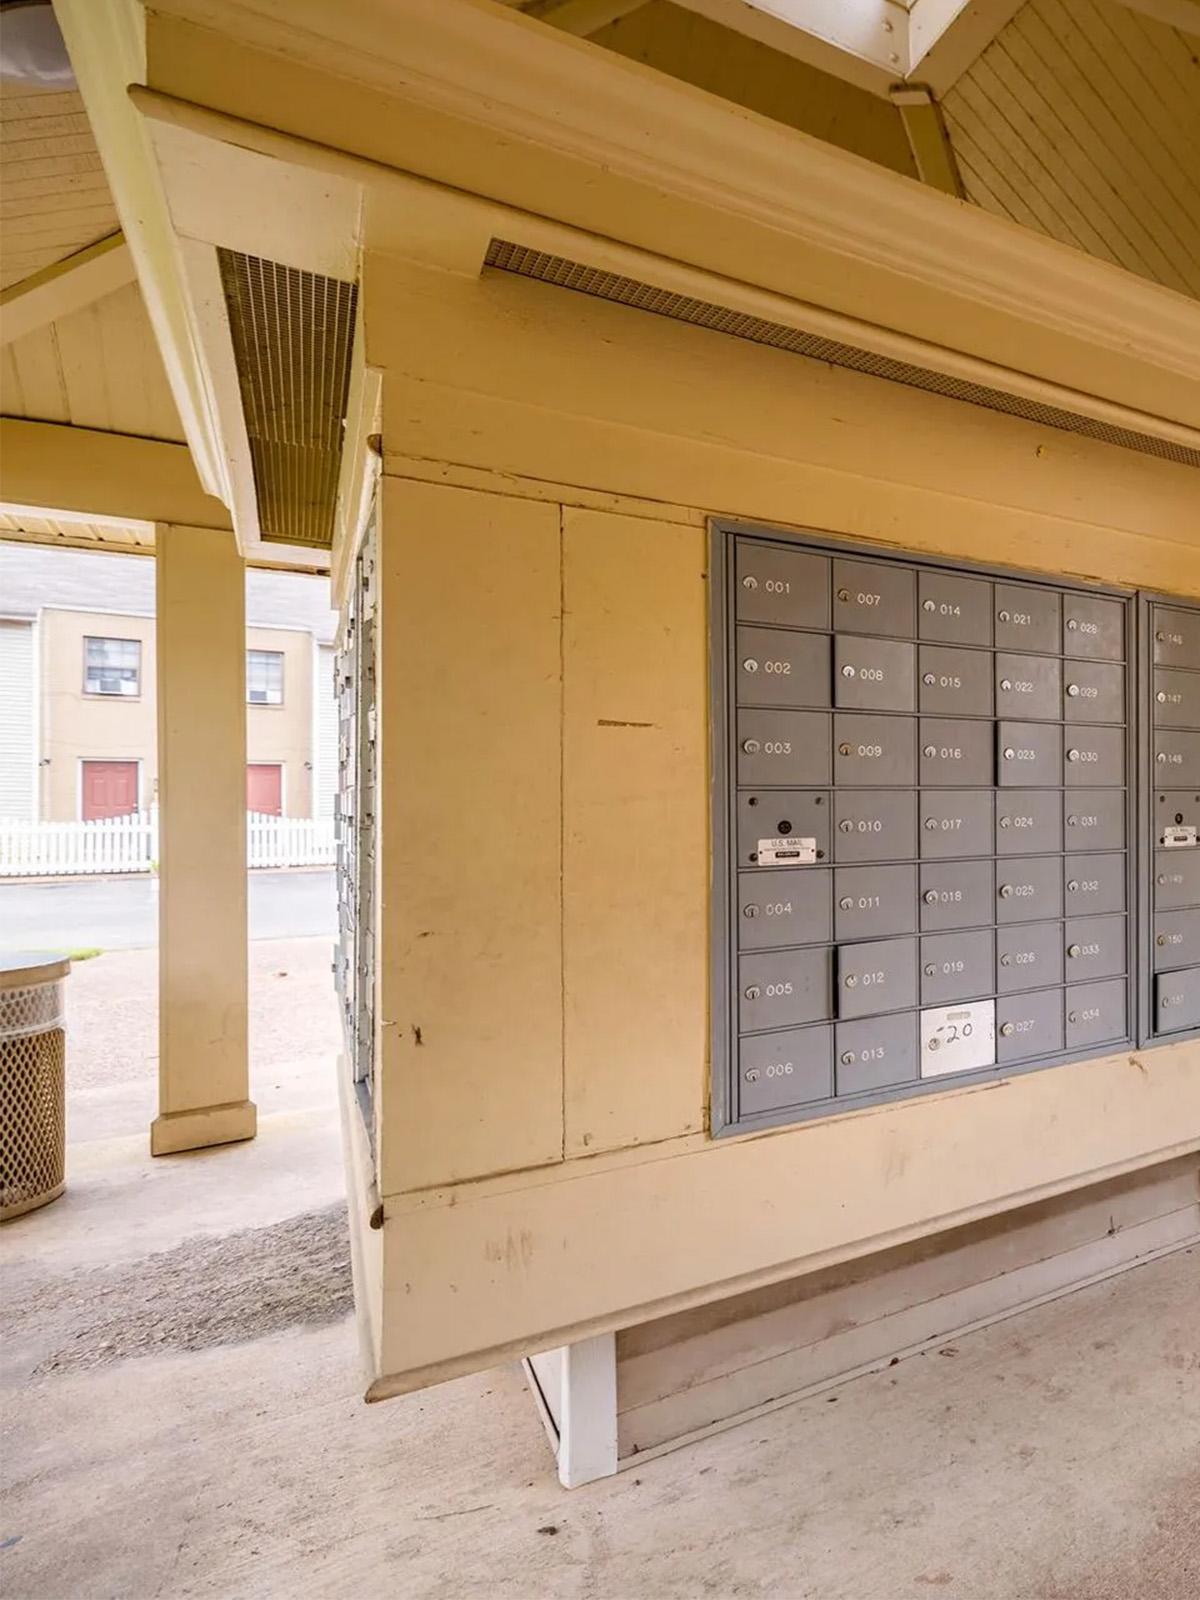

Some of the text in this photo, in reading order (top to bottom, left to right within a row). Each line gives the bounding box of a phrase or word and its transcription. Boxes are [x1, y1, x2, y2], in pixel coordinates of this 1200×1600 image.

[766, 580, 790, 593] 001
[858, 594, 881, 606] 007
[940, 604, 960, 616] 014
[1013, 614, 1031, 624] 021
[764, 662, 791, 674] 002
[860, 669, 884, 680] 008
[940, 677, 961, 688] 015
[764, 742, 792, 754] 003
[858, 746, 882, 757] 009
[940, 749, 961, 759] 016
[1080, 752, 1098, 762] 030
[858, 820, 882, 831] 010
[942, 819, 962, 830] 017
[1081, 817, 1097, 826] 031
[941, 890, 962, 901] 018
[859, 896, 880, 908] 011
[766, 902, 792, 915] 004
[943, 961, 963, 973] 019
[863, 972, 884, 984] 012
[766, 983, 792, 996] 005
[862, 1048, 884, 1061] 013
[766, 1063, 793, 1076] 006
